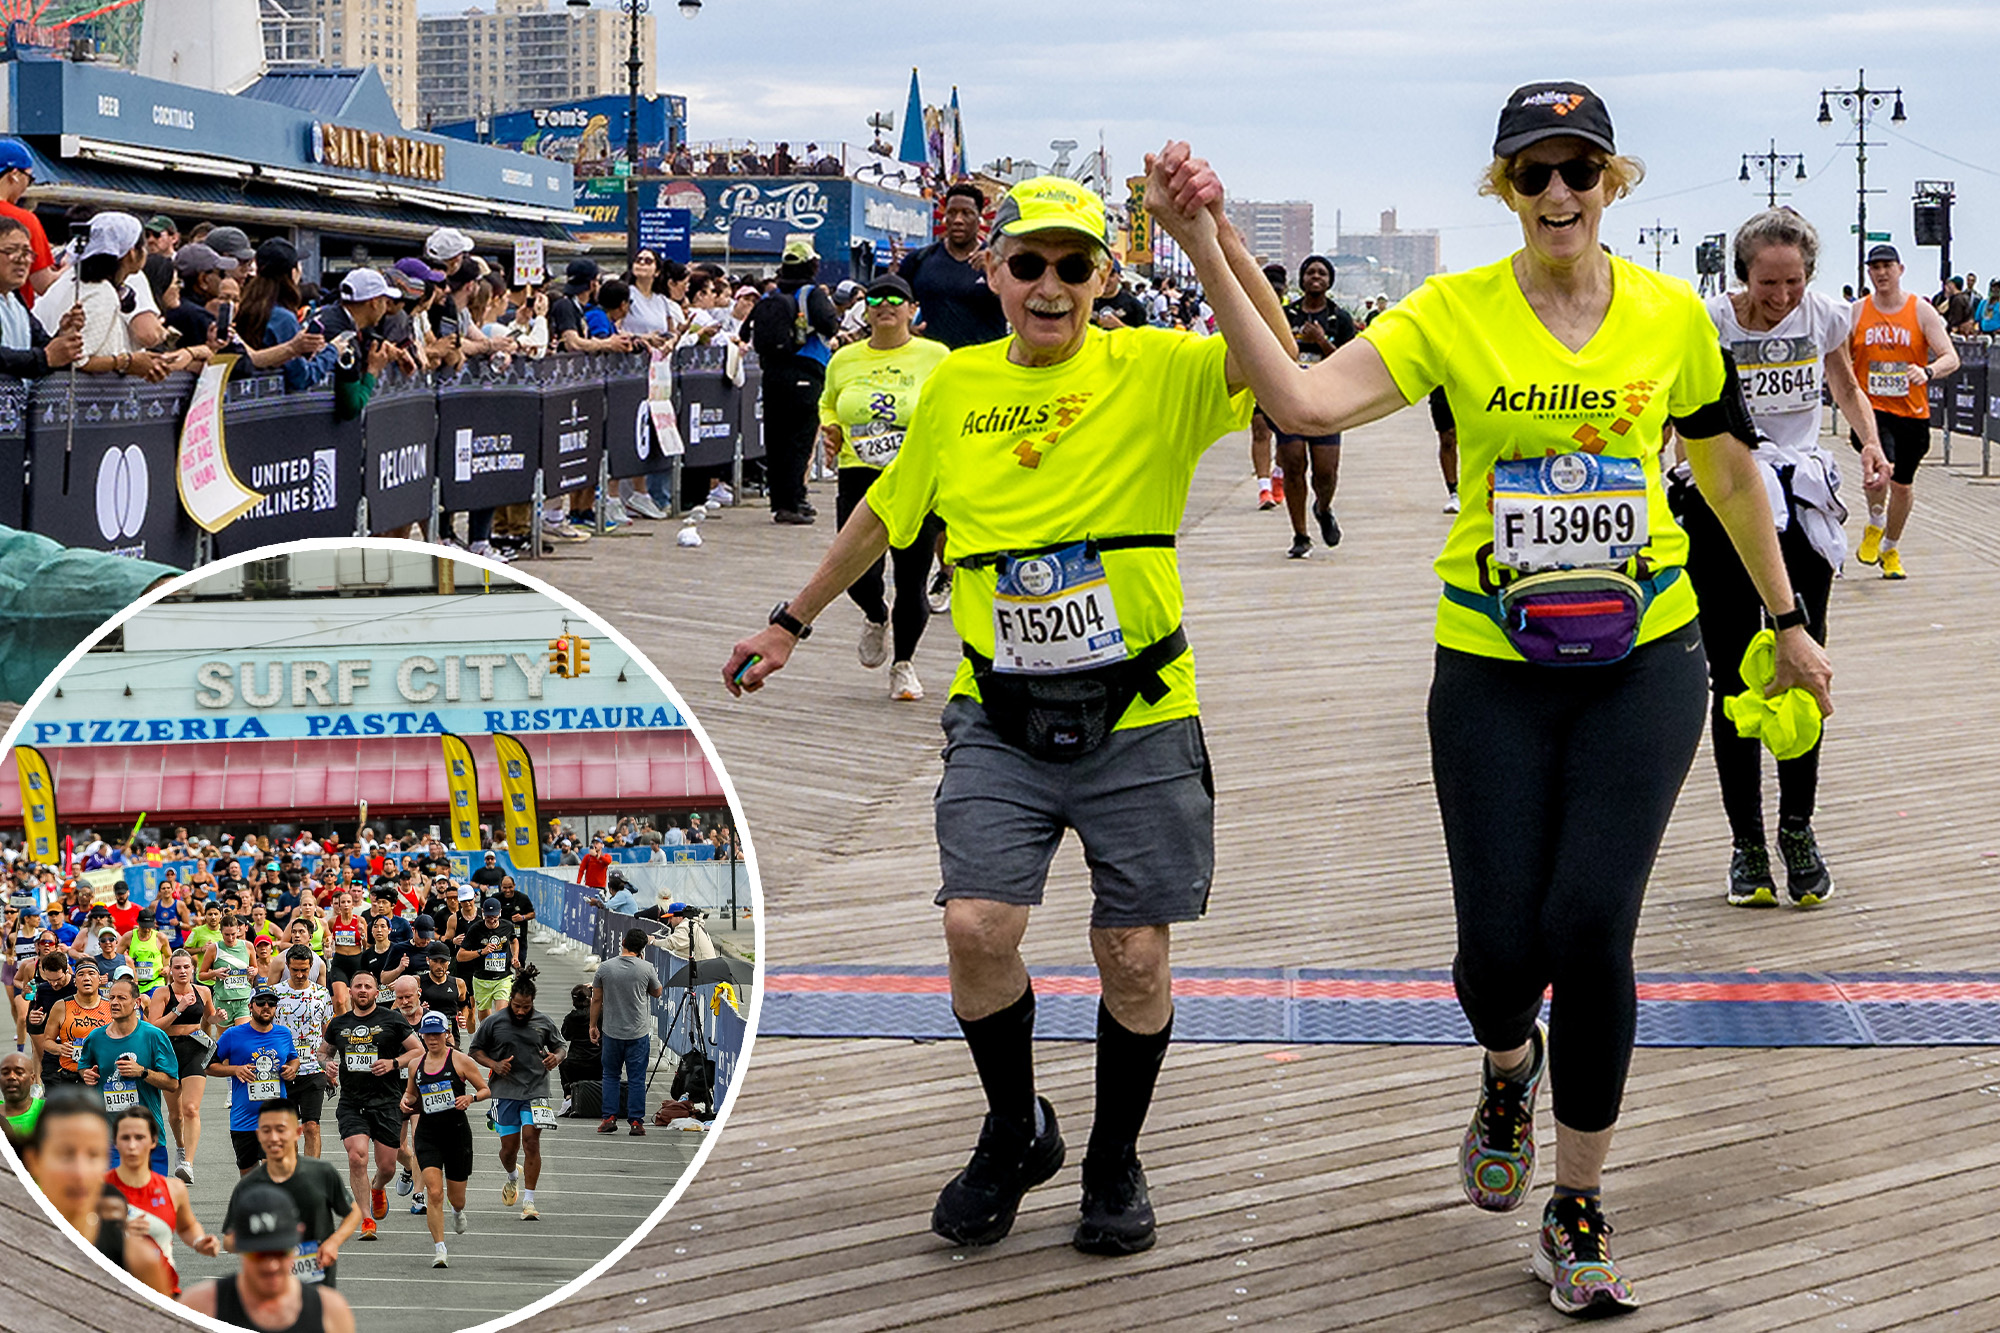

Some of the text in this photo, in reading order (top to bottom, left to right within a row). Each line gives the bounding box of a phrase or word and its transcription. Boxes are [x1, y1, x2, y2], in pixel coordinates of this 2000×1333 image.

[98, 95, 120, 118] BEER
[152, 104, 195, 130] COCKTAILS
[534, 108, 588, 127] Tom's
[321, 123, 368, 169] SALT
[386, 135, 446, 181] SIZZLE
[1865, 327, 1911, 347] BKLYN
[1486, 384, 1617, 412] Achilles
[1534, 412, 1616, 420] INTERNATIONAL
[252, 459, 310, 488] UNITED
[379, 442, 427, 491] PELOTON
[236, 487, 310, 520] IRLINES
[195, 653, 550, 709] SURF CITY
[33, 716, 270, 744] PIZZERIA
[306, 711, 447, 737] PASTA
[347, 1055, 373, 1065] D 7801
[250, 1082, 275, 1094] E 358
